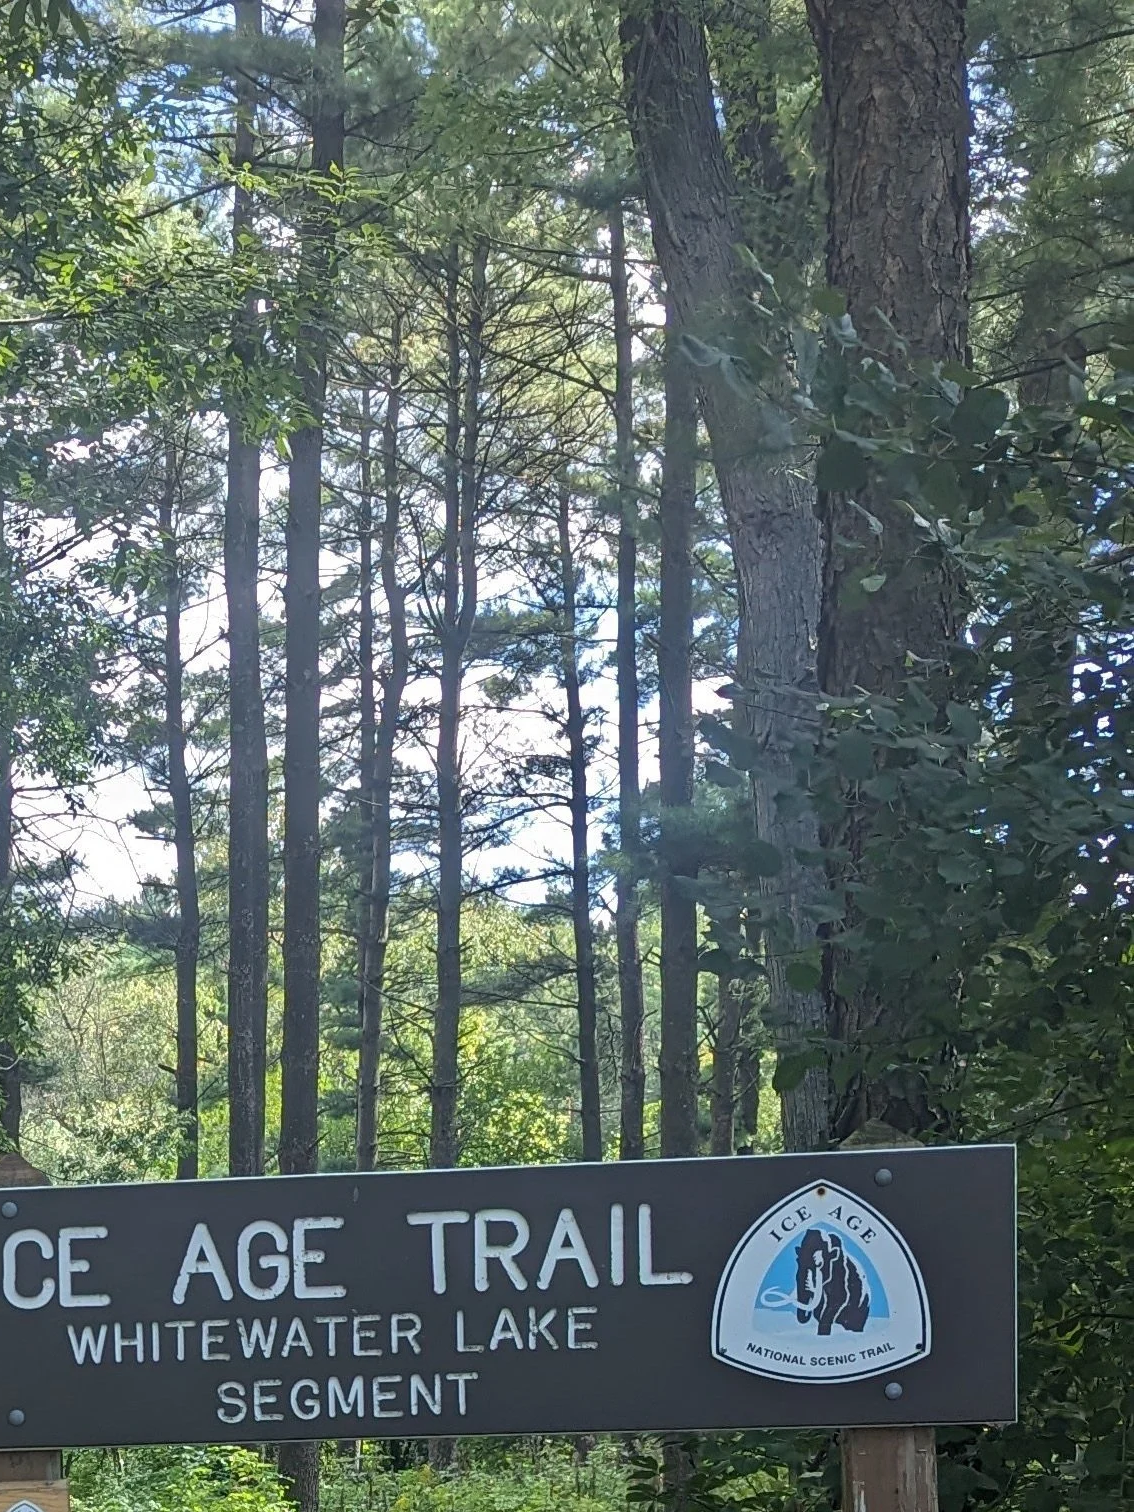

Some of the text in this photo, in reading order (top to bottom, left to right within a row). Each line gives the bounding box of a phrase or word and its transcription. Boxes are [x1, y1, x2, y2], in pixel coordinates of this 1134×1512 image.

[768, 1205, 877, 1245] ICE AGE
[172, 1216, 347, 1304] AGE
[406, 1203, 693, 1295] TRAIL
[67, 1306, 599, 1365] WHITEWATER LAKE
[746, 1342, 896, 1367] NATIONAL SCENIC TRAIL
[216, 1371, 479, 1425] SEGMENT
